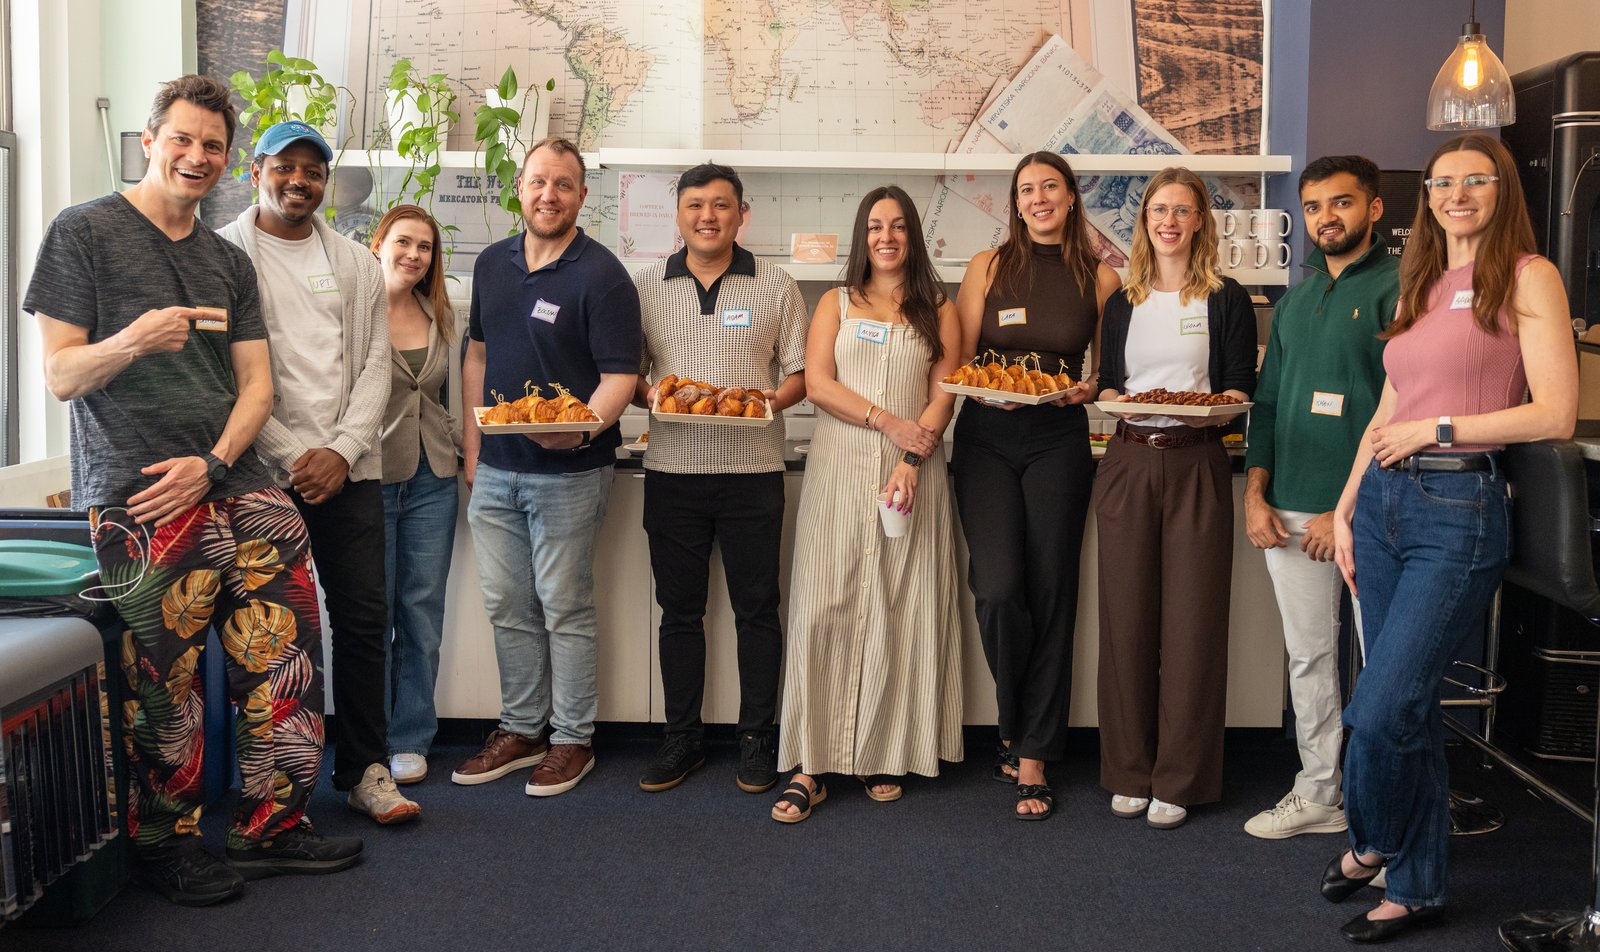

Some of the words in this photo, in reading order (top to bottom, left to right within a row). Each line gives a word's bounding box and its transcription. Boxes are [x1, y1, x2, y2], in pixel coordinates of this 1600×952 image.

[988, 94, 1016, 125] HRVATSKA
[1014, 64, 1040, 95] NARODNA
[1039, 43, 1060, 65] BANKA
[1042, 133, 1060, 153] ESET
[1058, 117, 1075, 137] KUNA
[456, 174, 482, 189] THE
[934, 186, 950, 217] NAROD
[989, 226, 1003, 249] KUNA
[1387, 247, 1402, 255] THE
[726, 313, 744, 321] ADAM
